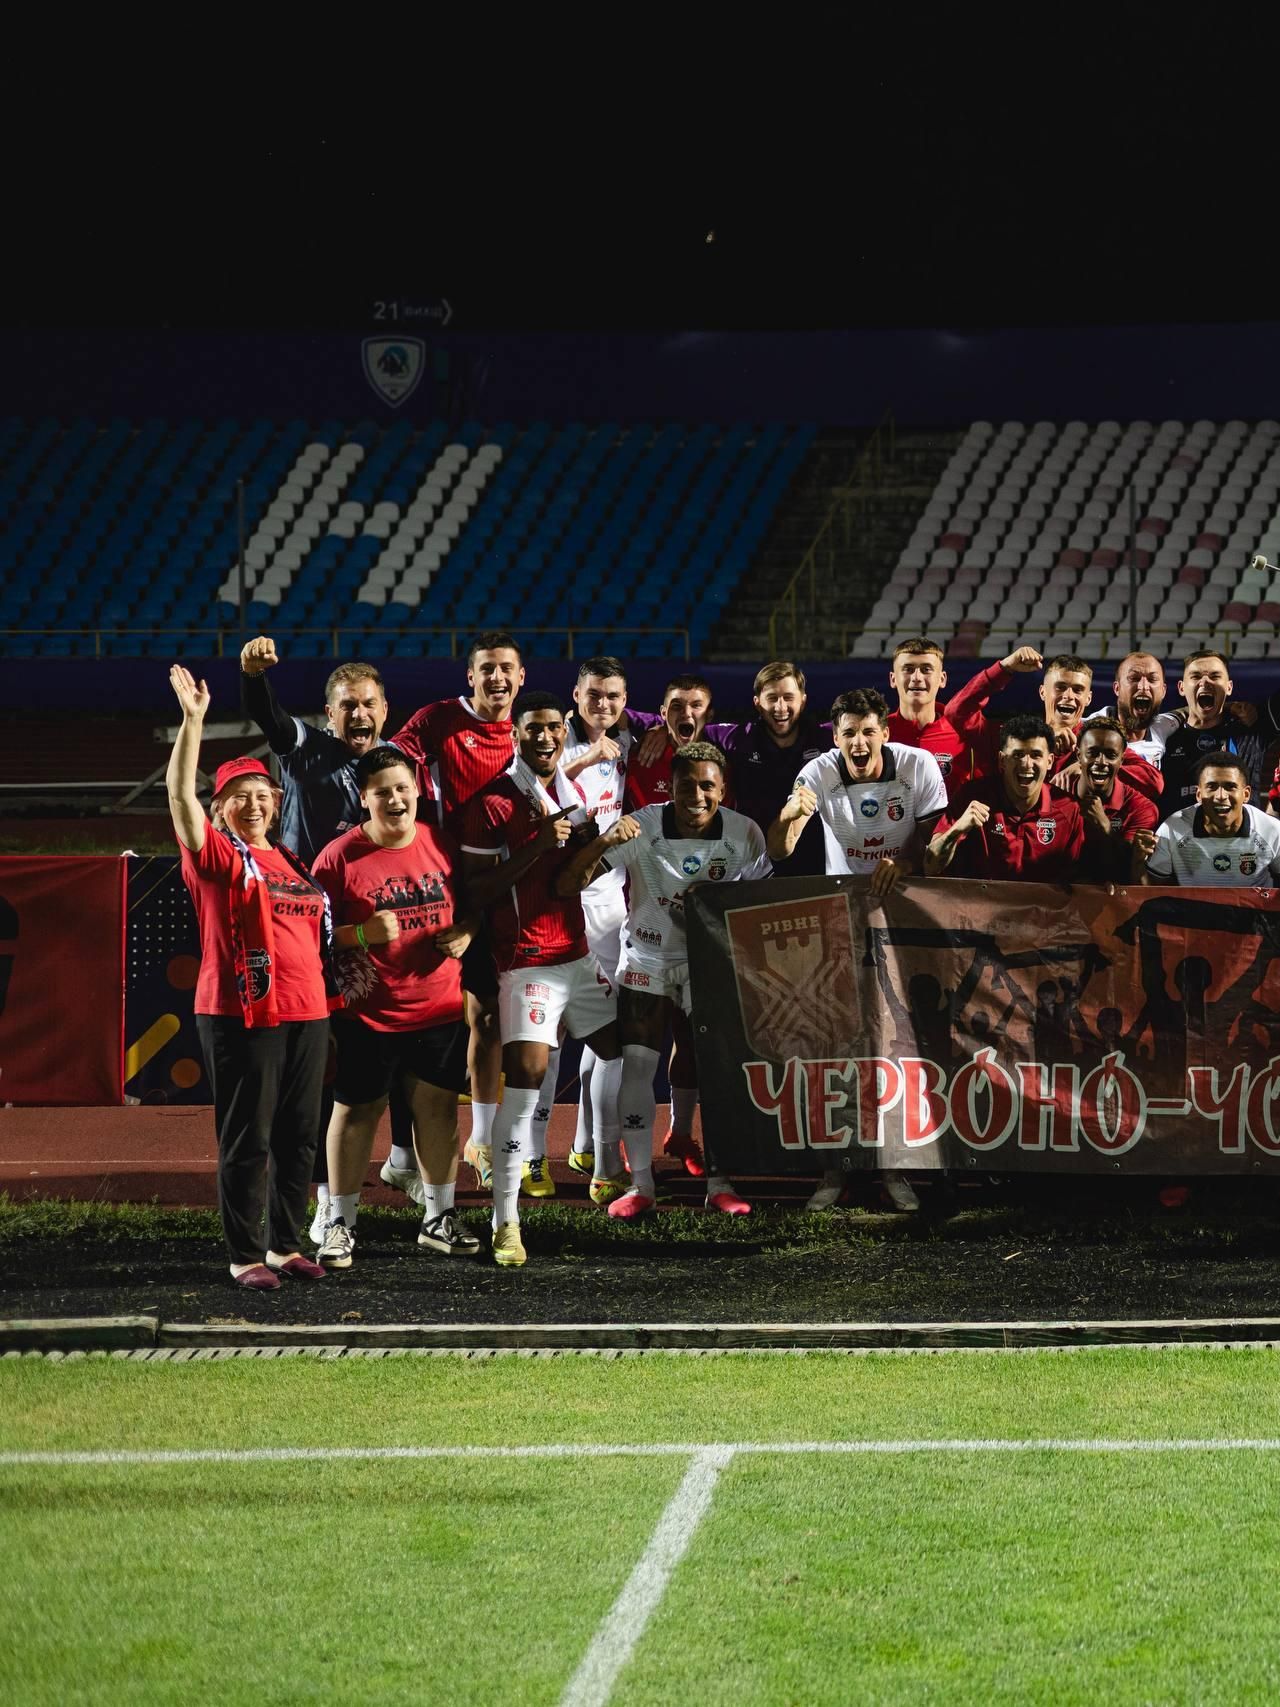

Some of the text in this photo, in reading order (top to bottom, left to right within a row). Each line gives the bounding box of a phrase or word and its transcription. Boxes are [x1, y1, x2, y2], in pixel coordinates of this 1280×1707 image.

[373, 301, 398, 320] 21
[847, 847, 900, 860] BETKING
[401, 913, 440, 931] ІМ'Я
[760, 915, 820, 936] РІВНЕ
